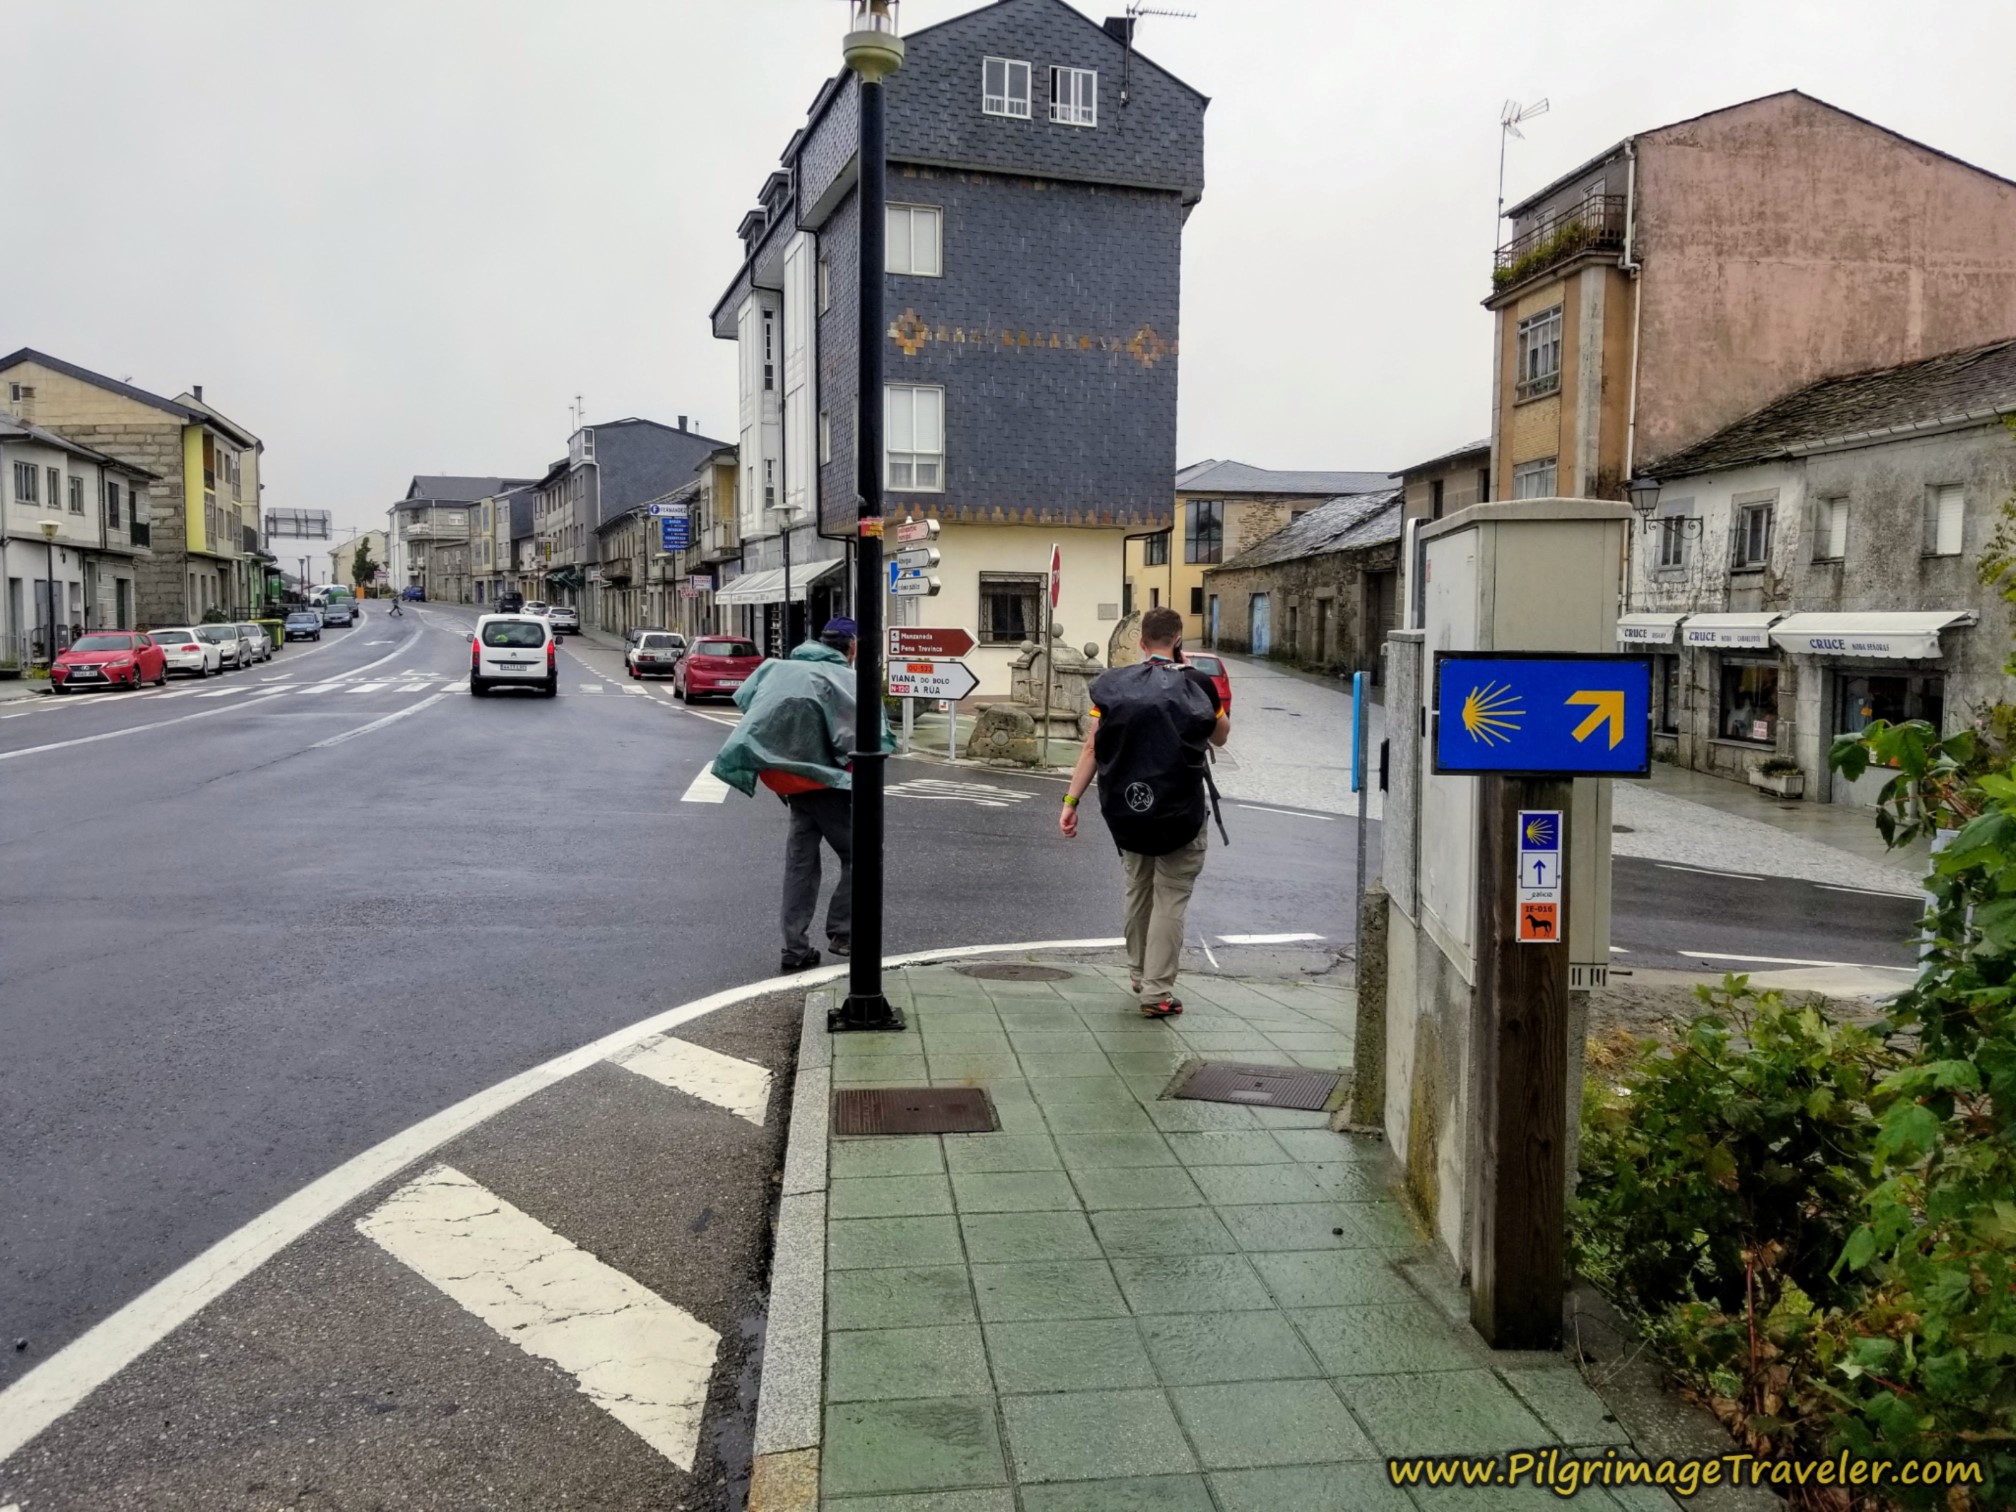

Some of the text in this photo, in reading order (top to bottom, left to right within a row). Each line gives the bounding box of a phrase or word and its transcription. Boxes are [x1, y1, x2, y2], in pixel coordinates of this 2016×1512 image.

[1624, 628, 1647, 639] CRUCE
[1688, 630, 1716, 642] CRUCE
[918, 645, 943, 653] Trevinca
[1809, 639, 1846, 650] CRUCE
[891, 674, 916, 683] VIANA
[891, 685, 910, 693] N-120
[923, 685, 941, 694] RÚA
[1525, 905, 1553, 913] IE-016
